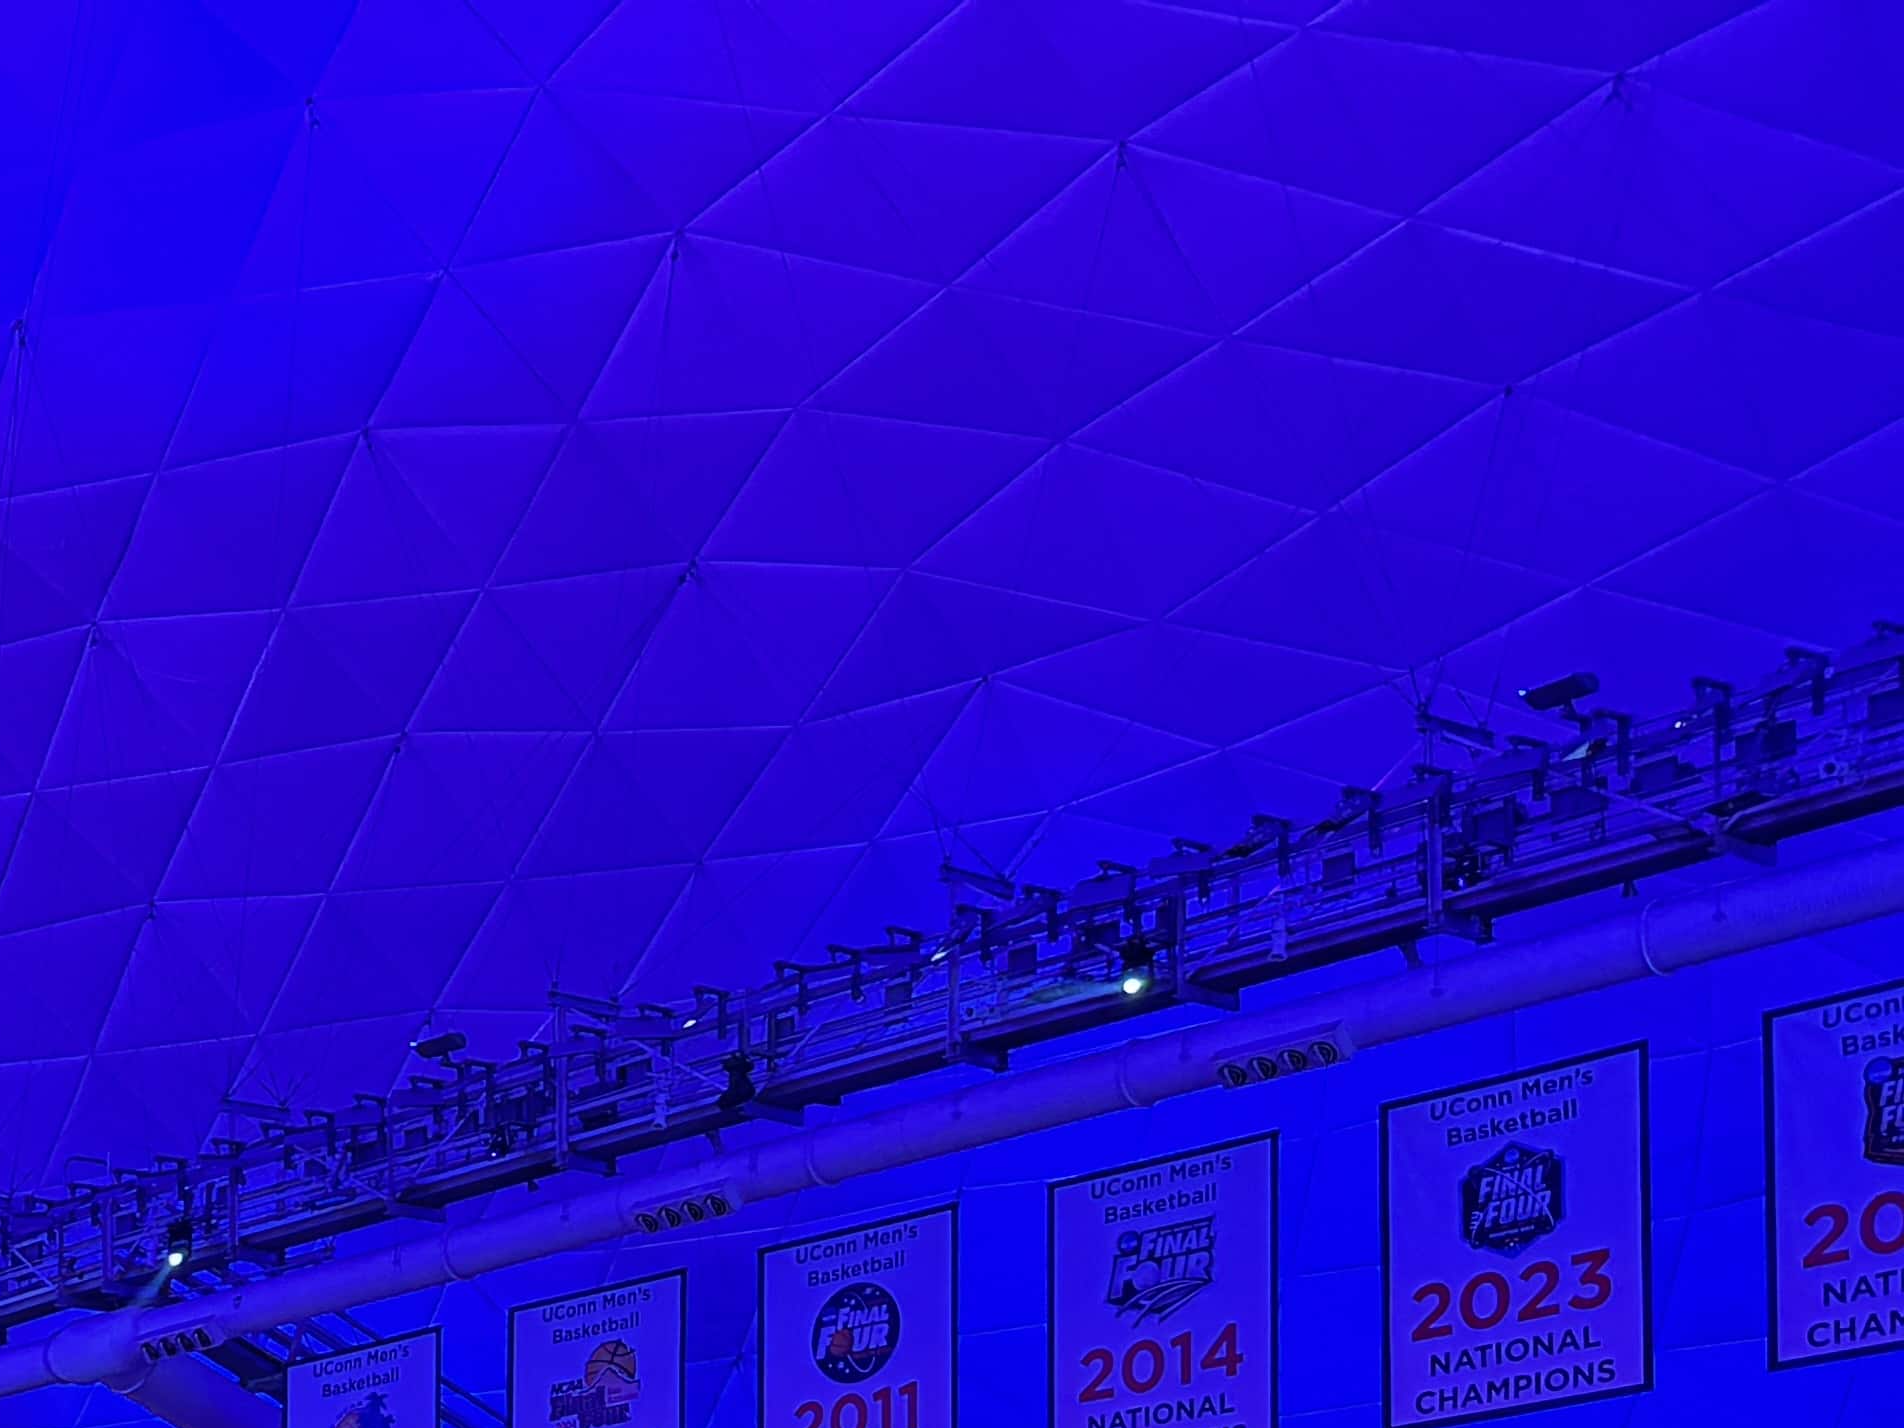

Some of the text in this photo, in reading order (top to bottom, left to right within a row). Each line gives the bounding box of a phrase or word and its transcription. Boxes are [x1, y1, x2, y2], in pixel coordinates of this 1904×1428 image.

[1430, 1066, 1595, 1121] UConn Men's
[1446, 1098, 1579, 1147] Basketball
[1090, 1155, 1233, 1200] UConn Men's
[1104, 1182, 1217, 1225] Basketball
[794, 1240, 856, 1265] UConn
[807, 1251, 906, 1287] Basketball
[542, 1298, 597, 1323] UConn
[1411, 1247, 1613, 1342] 2023
[552, 1310, 640, 1343] Basketball
[1078, 1321, 1245, 1404] 2014
[1428, 1325, 1602, 1377] NATIONAL
[322, 1367, 399, 1397] Basketball
[1415, 1357, 1616, 1415] CHAMPIONS
